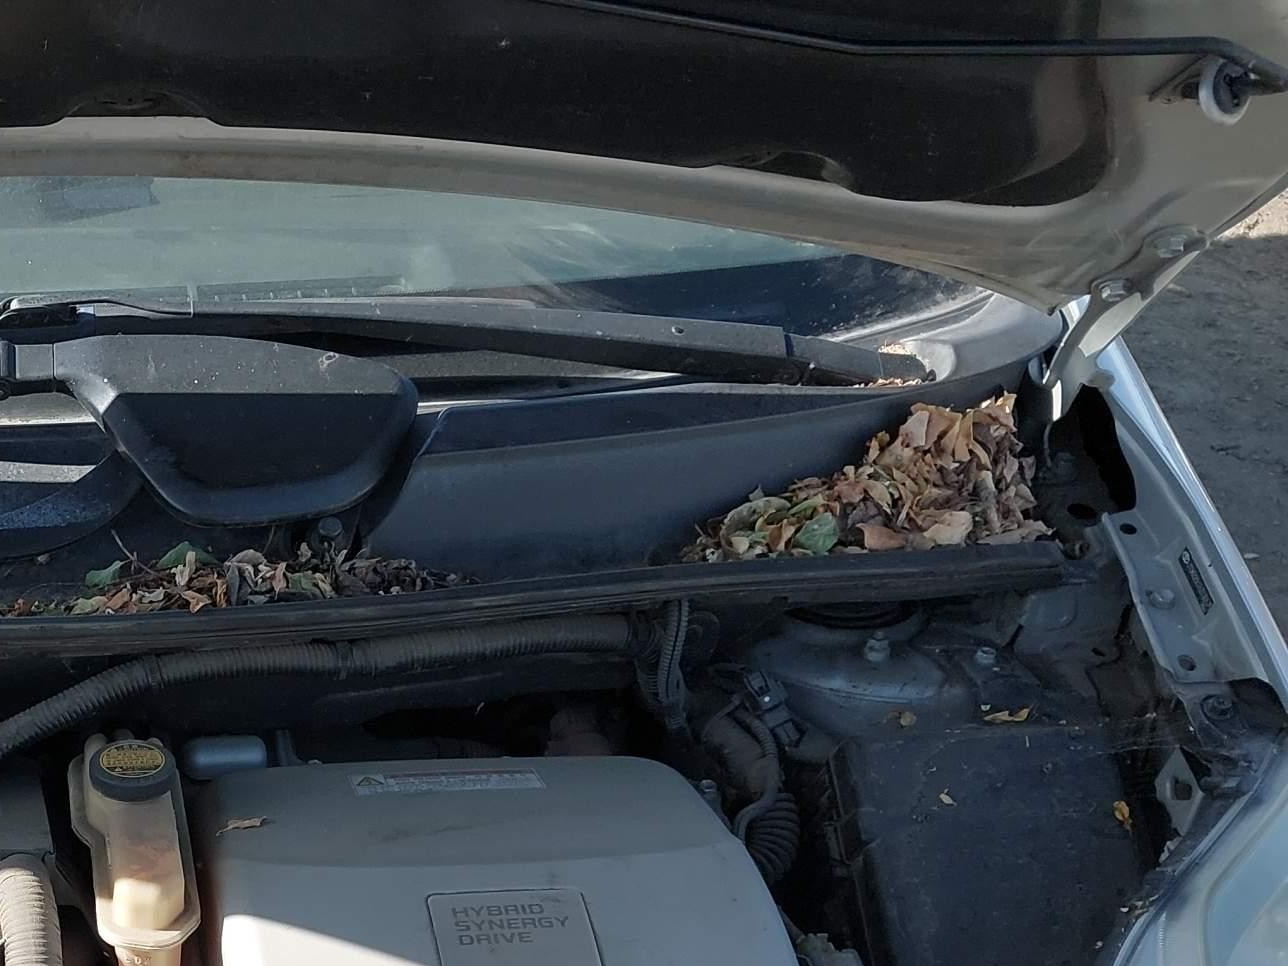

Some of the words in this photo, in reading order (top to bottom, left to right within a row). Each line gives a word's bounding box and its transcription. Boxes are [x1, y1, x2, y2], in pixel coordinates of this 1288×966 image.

[451, 903, 545, 918] HYBRID
[454, 916, 569, 932] SYNERGY
[457, 932, 534, 946] DRIVE
